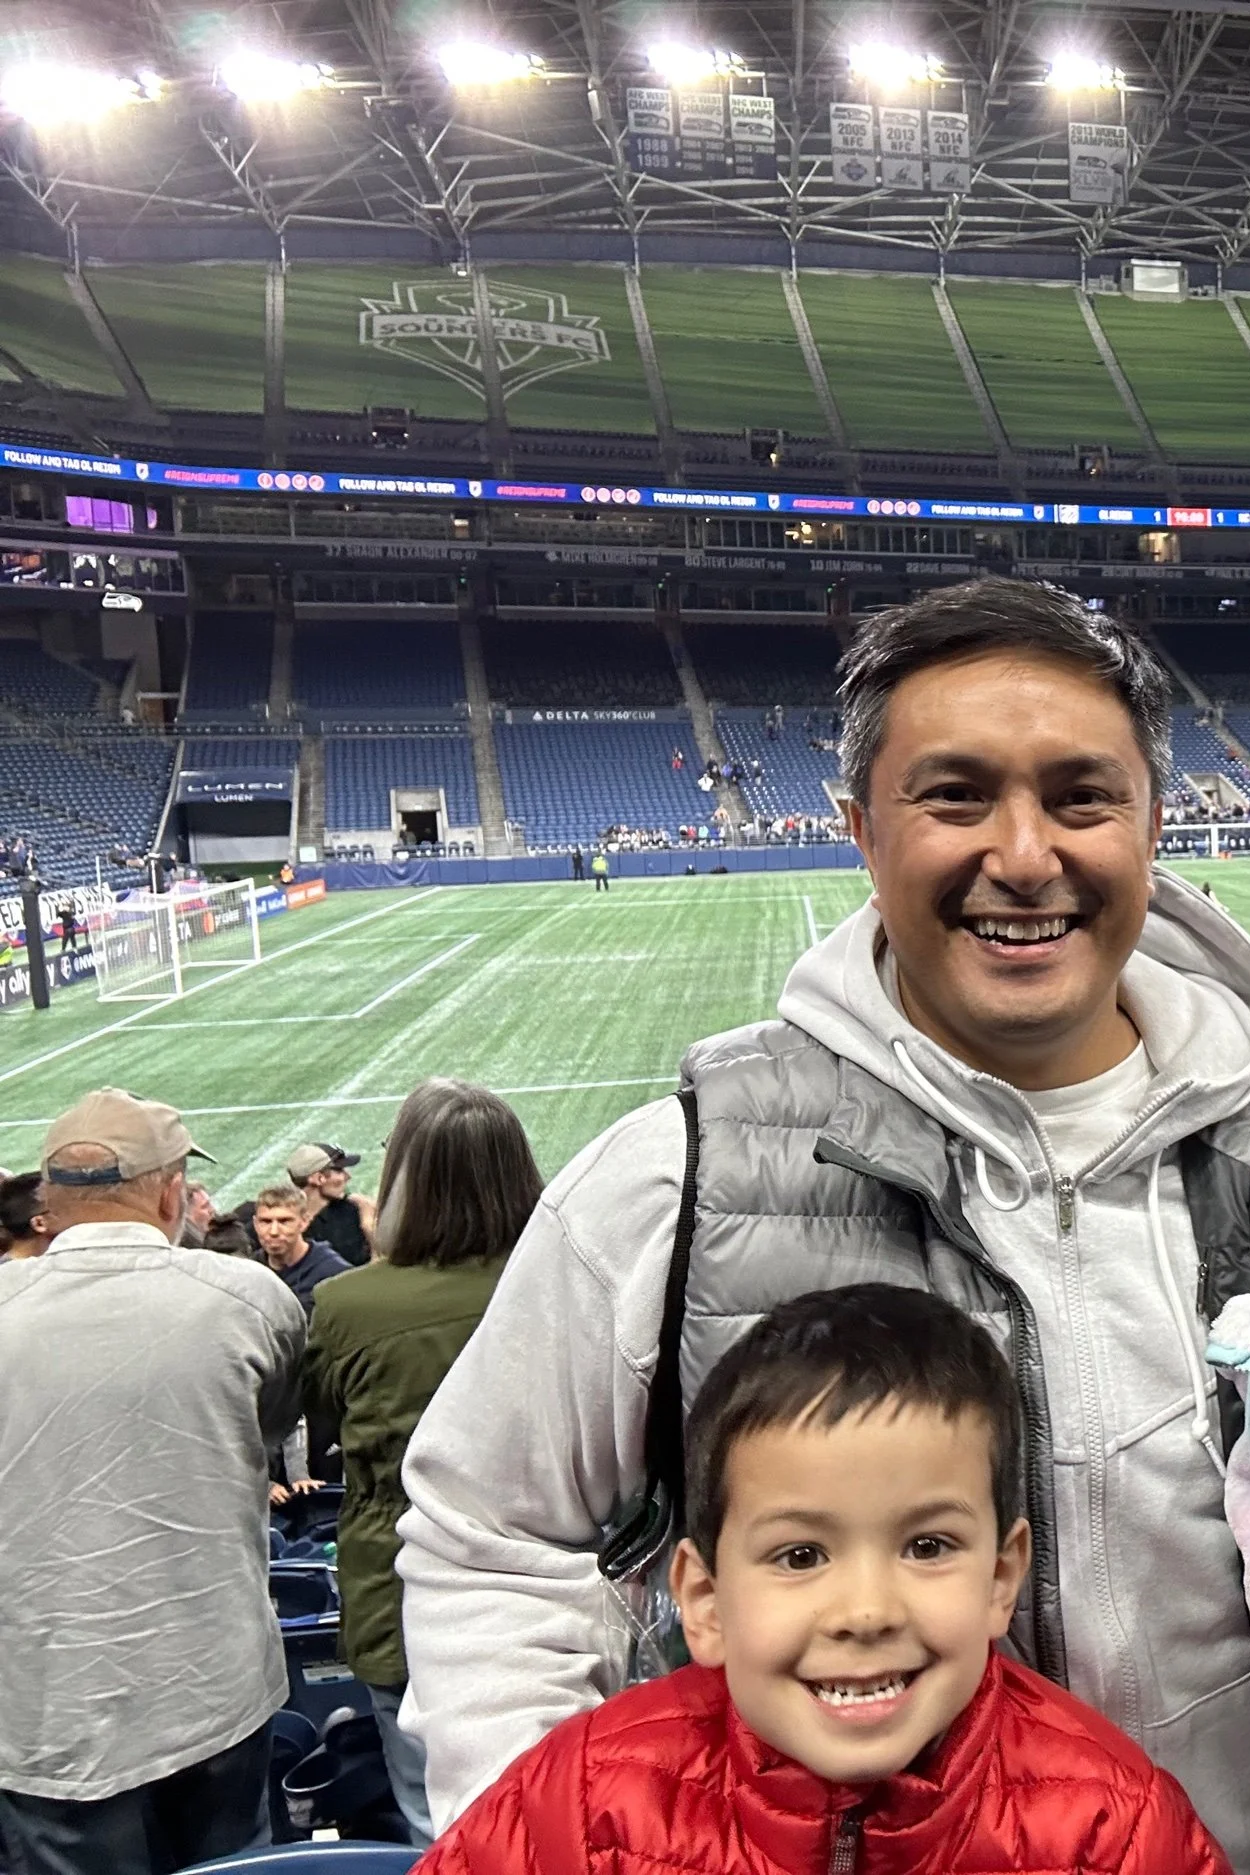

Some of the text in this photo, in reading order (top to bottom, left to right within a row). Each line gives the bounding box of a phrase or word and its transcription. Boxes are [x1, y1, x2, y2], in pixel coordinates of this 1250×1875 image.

[646, 91, 669, 100] WEST
[629, 100, 670, 112] CHAMPS
[749, 100, 772, 110] WEST
[732, 107, 773, 119] CHAMPS
[838, 123, 867, 136] 2005
[886, 128, 915, 141] 2013
[842, 136, 864, 147] NFC
[934, 131, 963, 144] 2014
[890, 141, 912, 152] NFC
[938, 145, 960, 155] NFC
[556, 333, 593, 349] FC
[4, 450, 41, 465] FOLLOW
[42, 455, 62, 468] AND
[62, 457, 80, 470] TAG
[81, 459, 92, 471] OL
[339, 479, 376, 490] FOLLOW
[1153, 510, 1161, 522] 1
[1217, 511, 1224, 523] 1
[386, 545, 448, 560] ALEXANDER
[703, 557, 727, 569] STEVE
[729, 558, 766, 569] LARGENT
[906, 562, 919, 573] 22
[546, 711, 589, 720] DELTA
[187, 782, 283, 793] LUMEN
[214, 794, 254, 803] LUMEN
